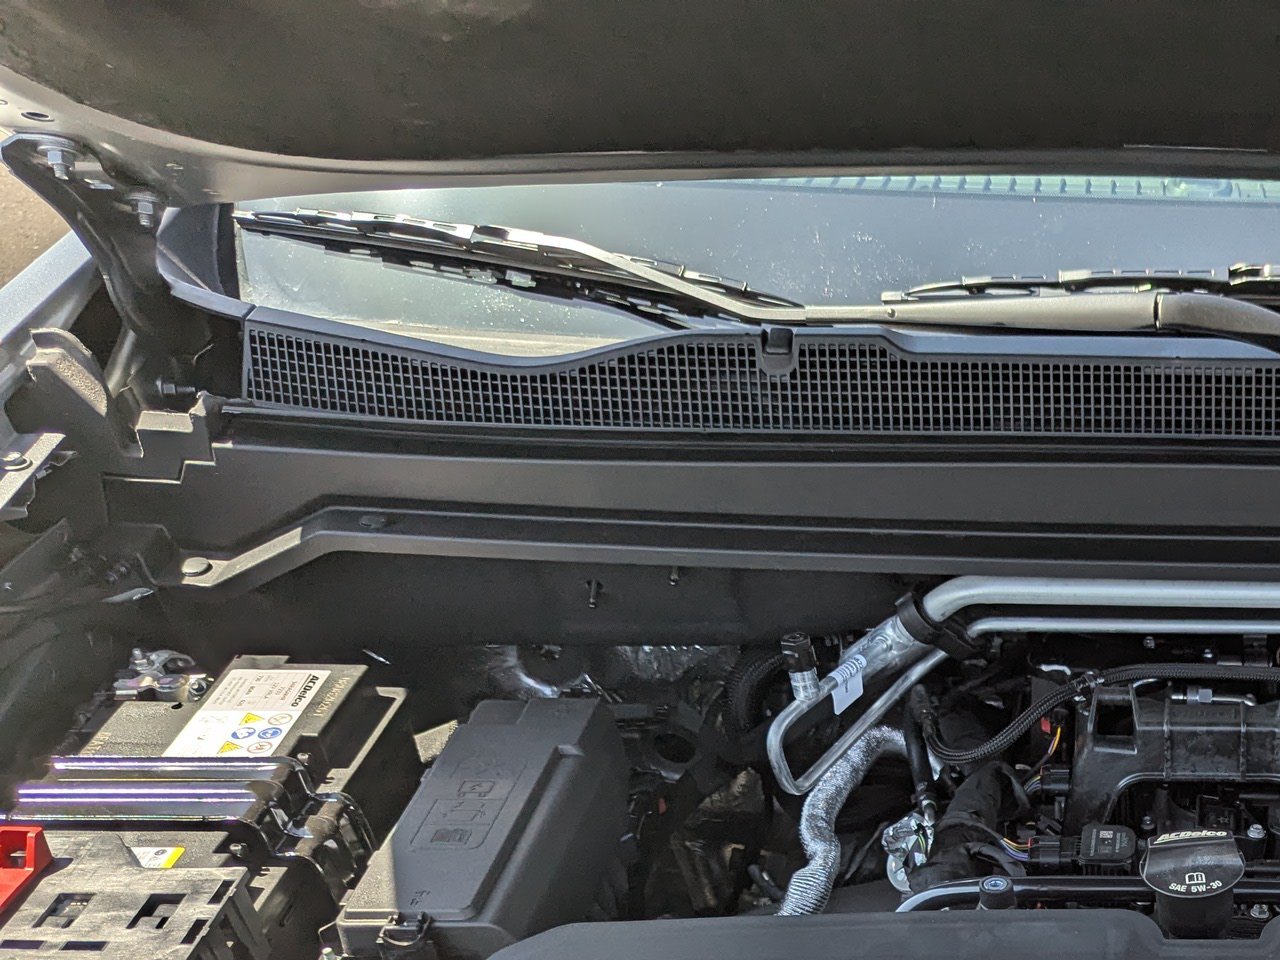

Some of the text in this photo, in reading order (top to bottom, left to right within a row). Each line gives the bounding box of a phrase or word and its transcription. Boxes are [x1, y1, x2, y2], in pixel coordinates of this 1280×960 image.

[290, 675, 320, 708] ACDelco
[1153, 830, 1228, 845] ACDelco
[1168, 880, 1223, 893] SAE 5W-30
